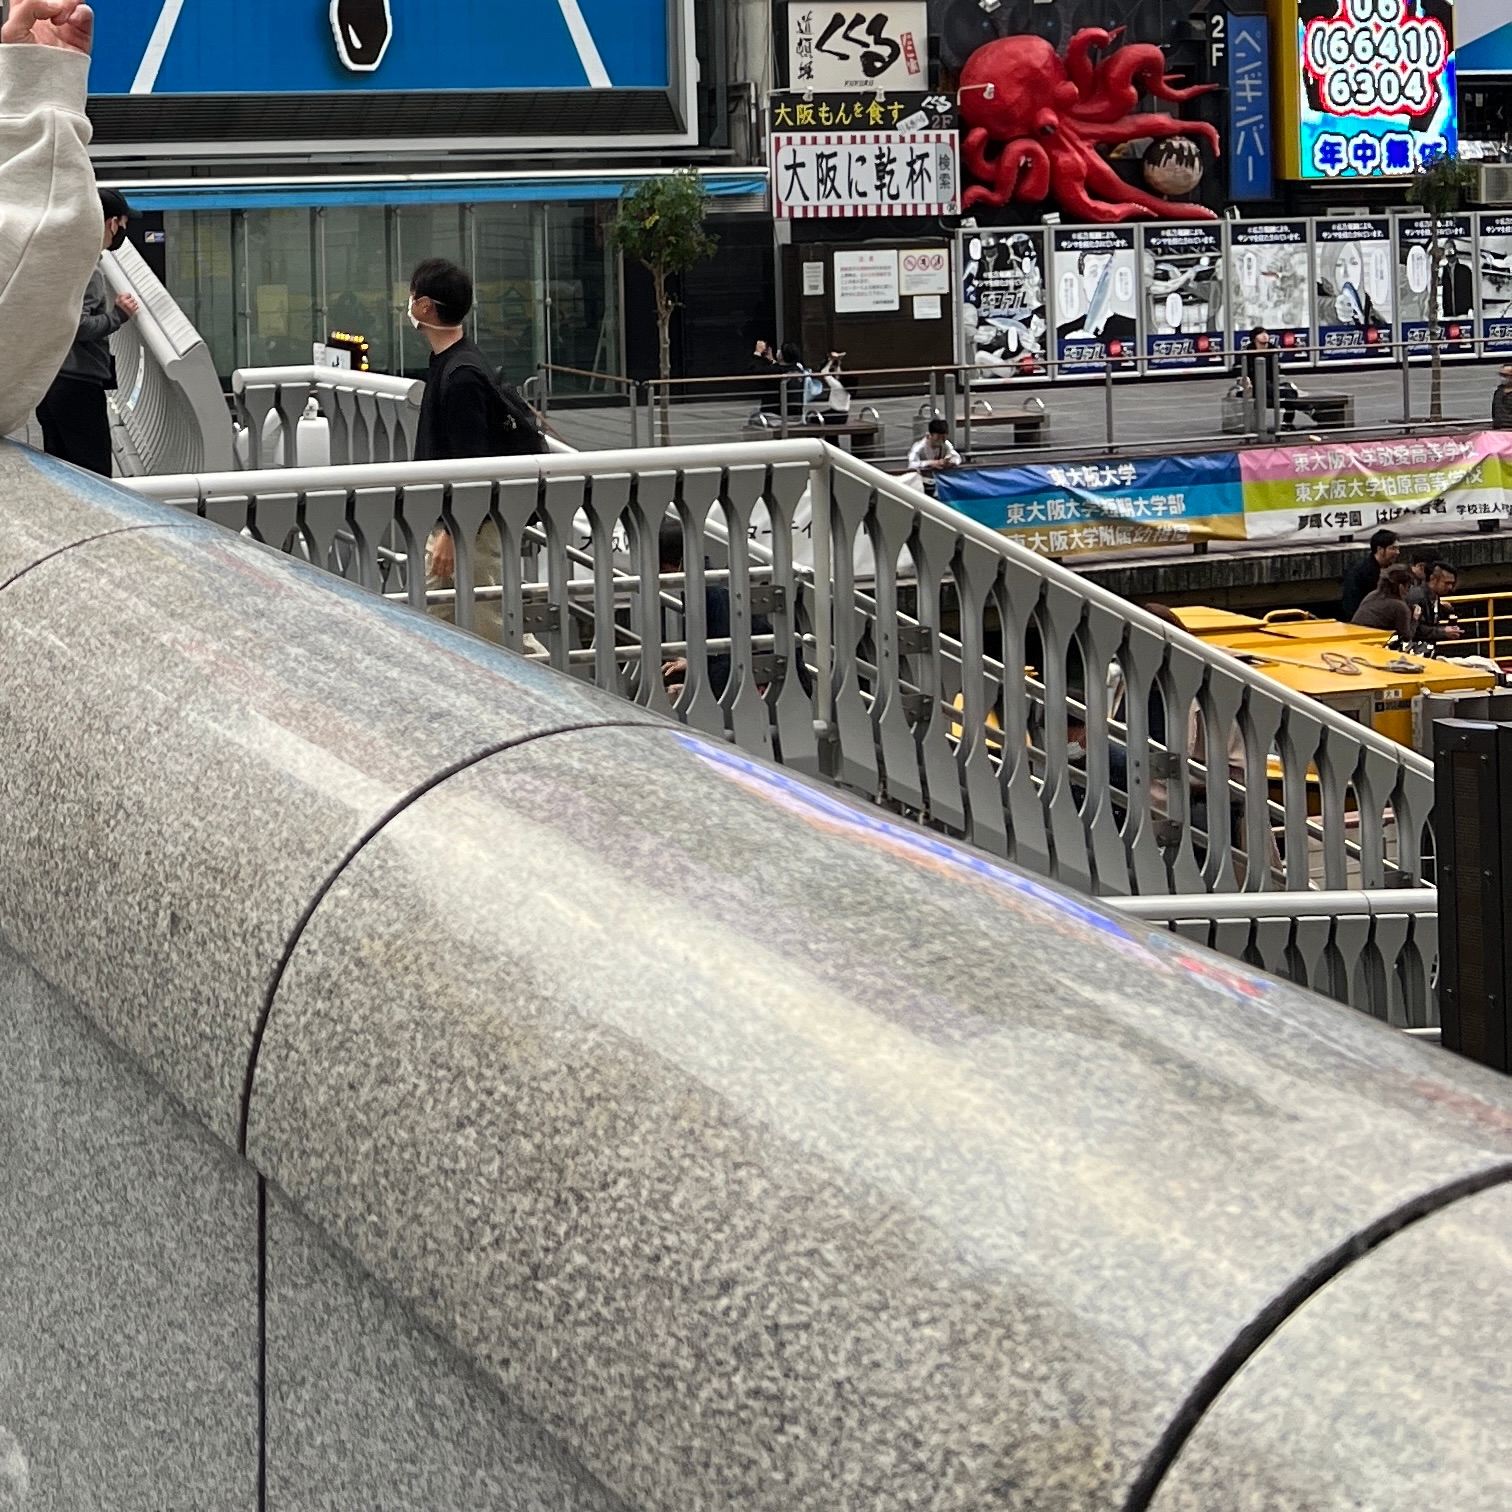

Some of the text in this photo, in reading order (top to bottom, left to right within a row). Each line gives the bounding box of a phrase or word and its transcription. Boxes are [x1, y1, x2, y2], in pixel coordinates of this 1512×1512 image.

[815, 11, 901, 78] くくる
[1210, 15, 1225, 67] 2F
[1310, 26, 1442, 67] (6641)
[1235, 30, 1264, 182] ペンギンバー
[1328, 68, 1429, 110] 6304
[774, 101, 905, 127] 大阪もんを食す
[930, 114, 953, 129] 2F
[784, 146, 931, 202] 大阪に乾杯
[1048, 464, 1137, 487] 東大阪大学
[1007, 494, 1186, 524] 東大阪大学短期大学部
